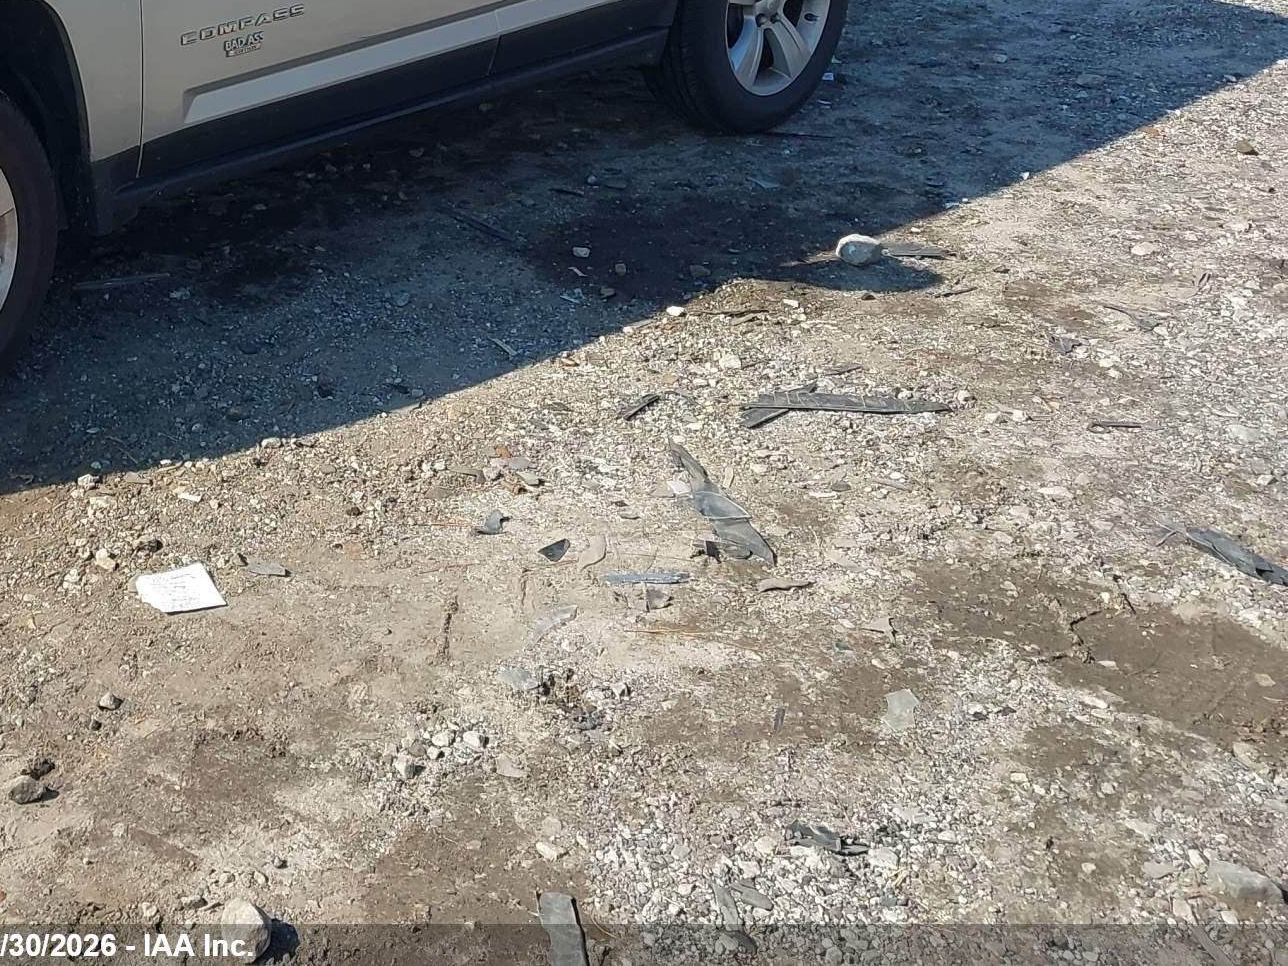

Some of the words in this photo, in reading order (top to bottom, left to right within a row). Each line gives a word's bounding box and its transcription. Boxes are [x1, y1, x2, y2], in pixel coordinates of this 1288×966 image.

[181, 3, 305, 46] COMPASS
[223, 36, 246, 52] BAD
[246, 31, 265, 46] ASS
